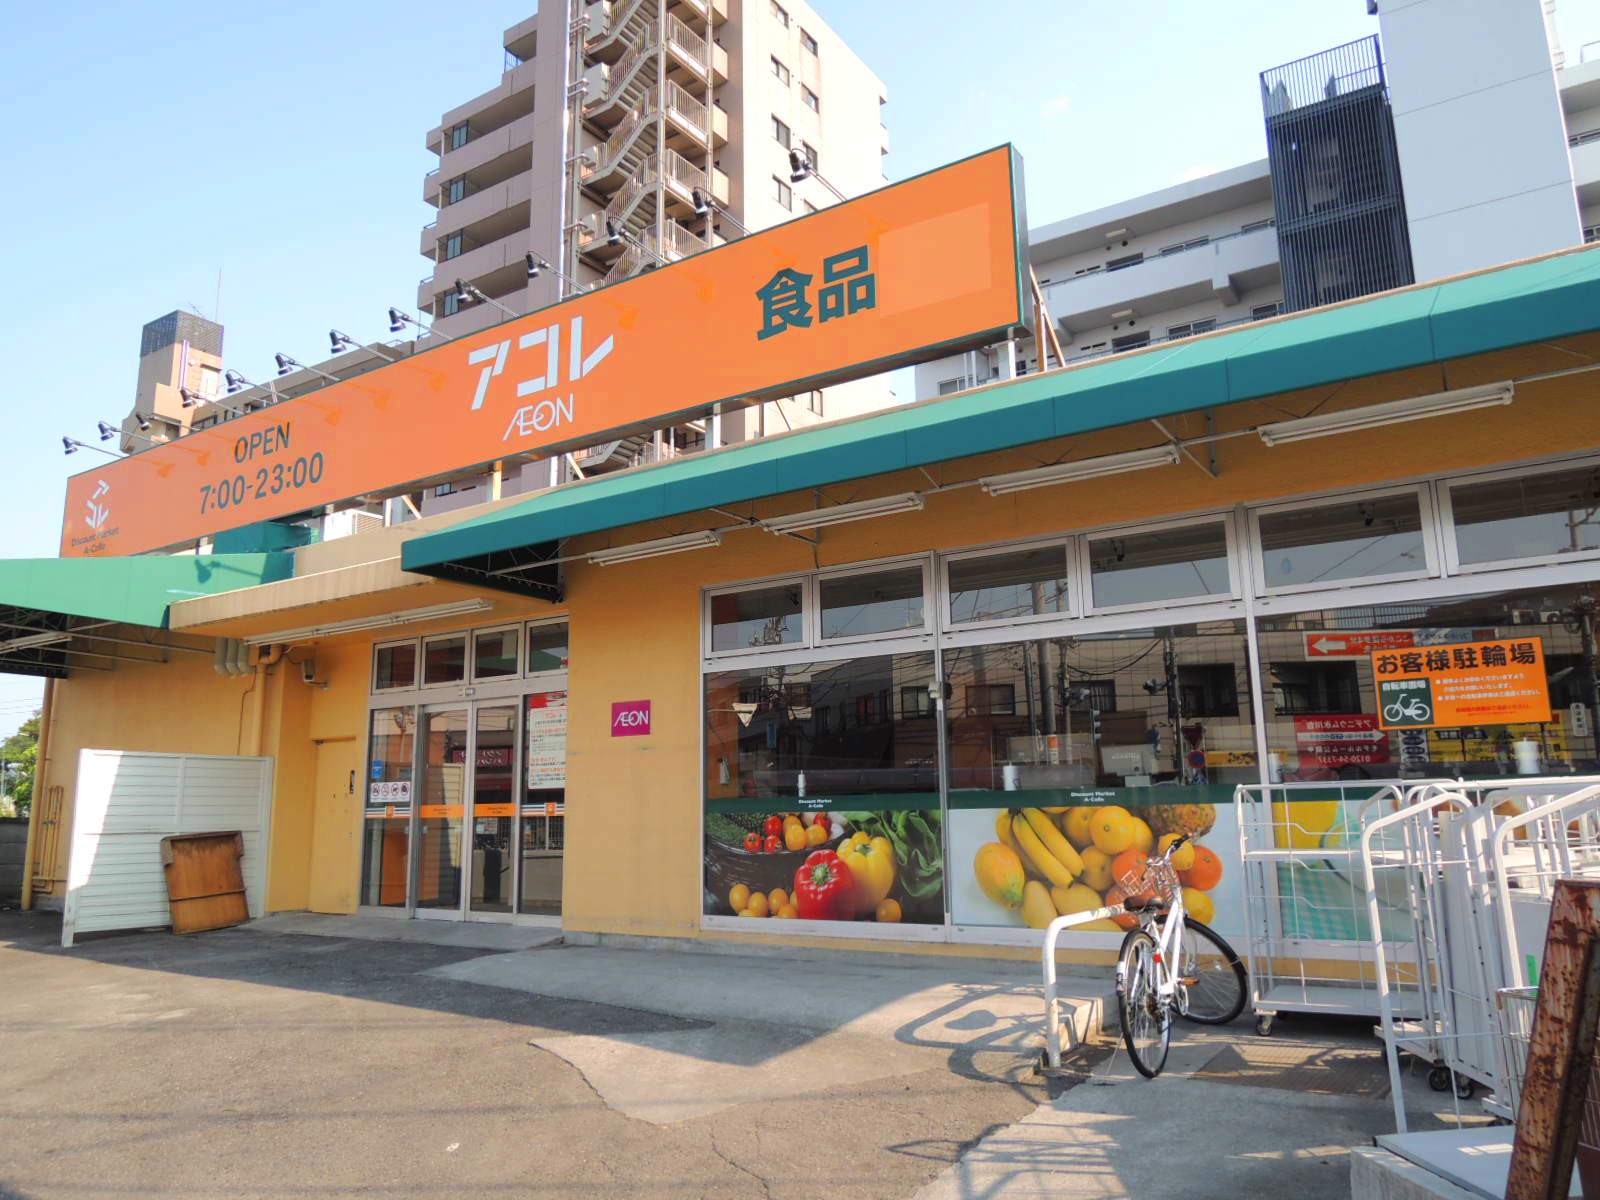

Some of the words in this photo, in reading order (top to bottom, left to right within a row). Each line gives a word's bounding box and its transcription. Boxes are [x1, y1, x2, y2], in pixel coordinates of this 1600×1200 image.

[755, 244, 877, 341] 食品
[468, 315, 614, 410] アコレ
[234, 421, 291, 464] OPEN
[200, 452, 324, 514] 7:00-23:00
[1376, 642, 1536, 674] お客様駐輪場
